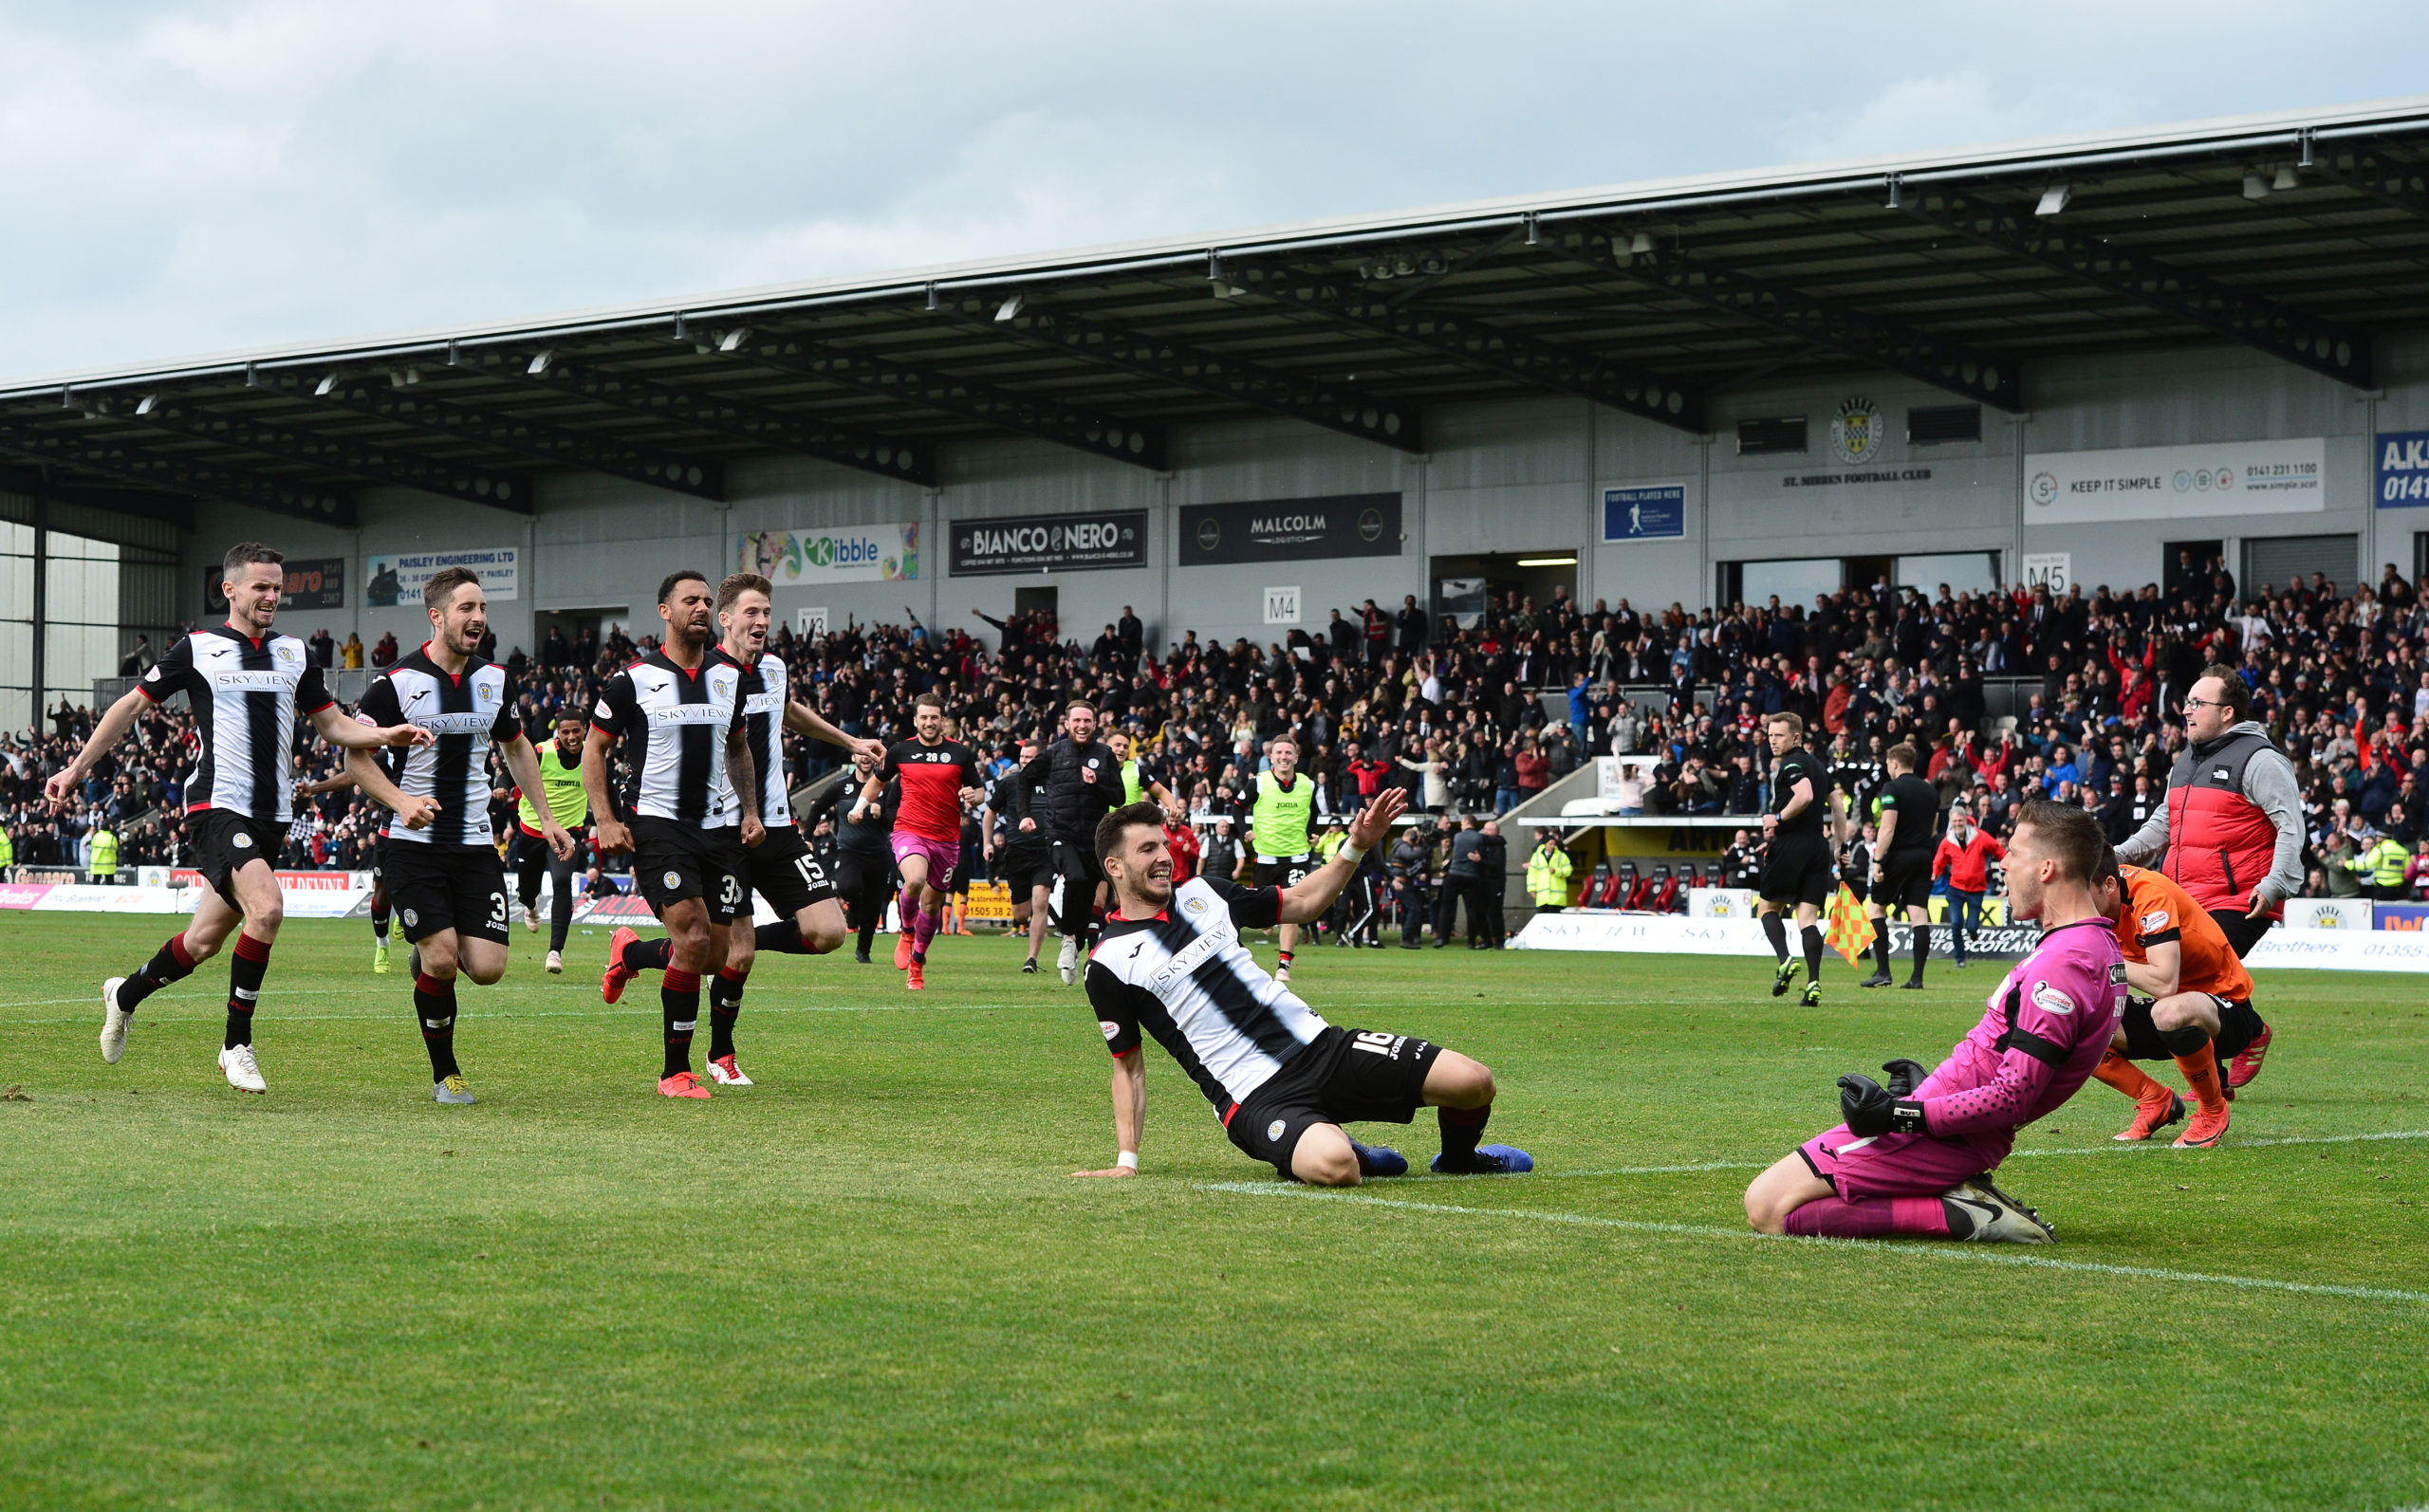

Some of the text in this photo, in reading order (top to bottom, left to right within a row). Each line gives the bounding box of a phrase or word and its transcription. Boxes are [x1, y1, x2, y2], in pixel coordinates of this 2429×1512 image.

[2247, 465, 2270, 476] 0141
[2294, 463, 2317, 474] 1100
[1801, 474, 1842, 487] MIRREN
[1845, 471, 1901, 484] FOOTBALL
[1901, 470, 1931, 481] CLUB
[2071, 481, 2101, 493] KEEP
[2105, 480, 2115, 490] IT
[2118, 477, 2161, 490] SIMPLE
[1251, 515, 1326, 533] MALCOLM
[973, 523, 1118, 555] BIANCO NERO
[817, 538, 879, 564] Kibble
[399, 552, 513, 568] PAISLEY ENGINEERING LTD
[2029, 566, 2065, 592] M5
[1270, 597, 1295, 618] M4
[658, 705, 729, 720] SKYVIEW
[418, 714, 491, 729] SKYVIEW
[15, 867, 76, 884] Gennaro
[794, 854, 825, 883] 15
[297, 877, 343, 890] DEVINE
[490, 892, 506, 921] 3
[582, 914, 613, 924] HOME
[1964, 940, 2037, 953] SCOTLAN
[2255, 940, 2425, 957] Brothers 01355
[1158, 927, 1227, 985] SKYVIEW
[2042, 992, 2072, 1006] Ladbrokes
[1351, 1032, 1395, 1056] 16
